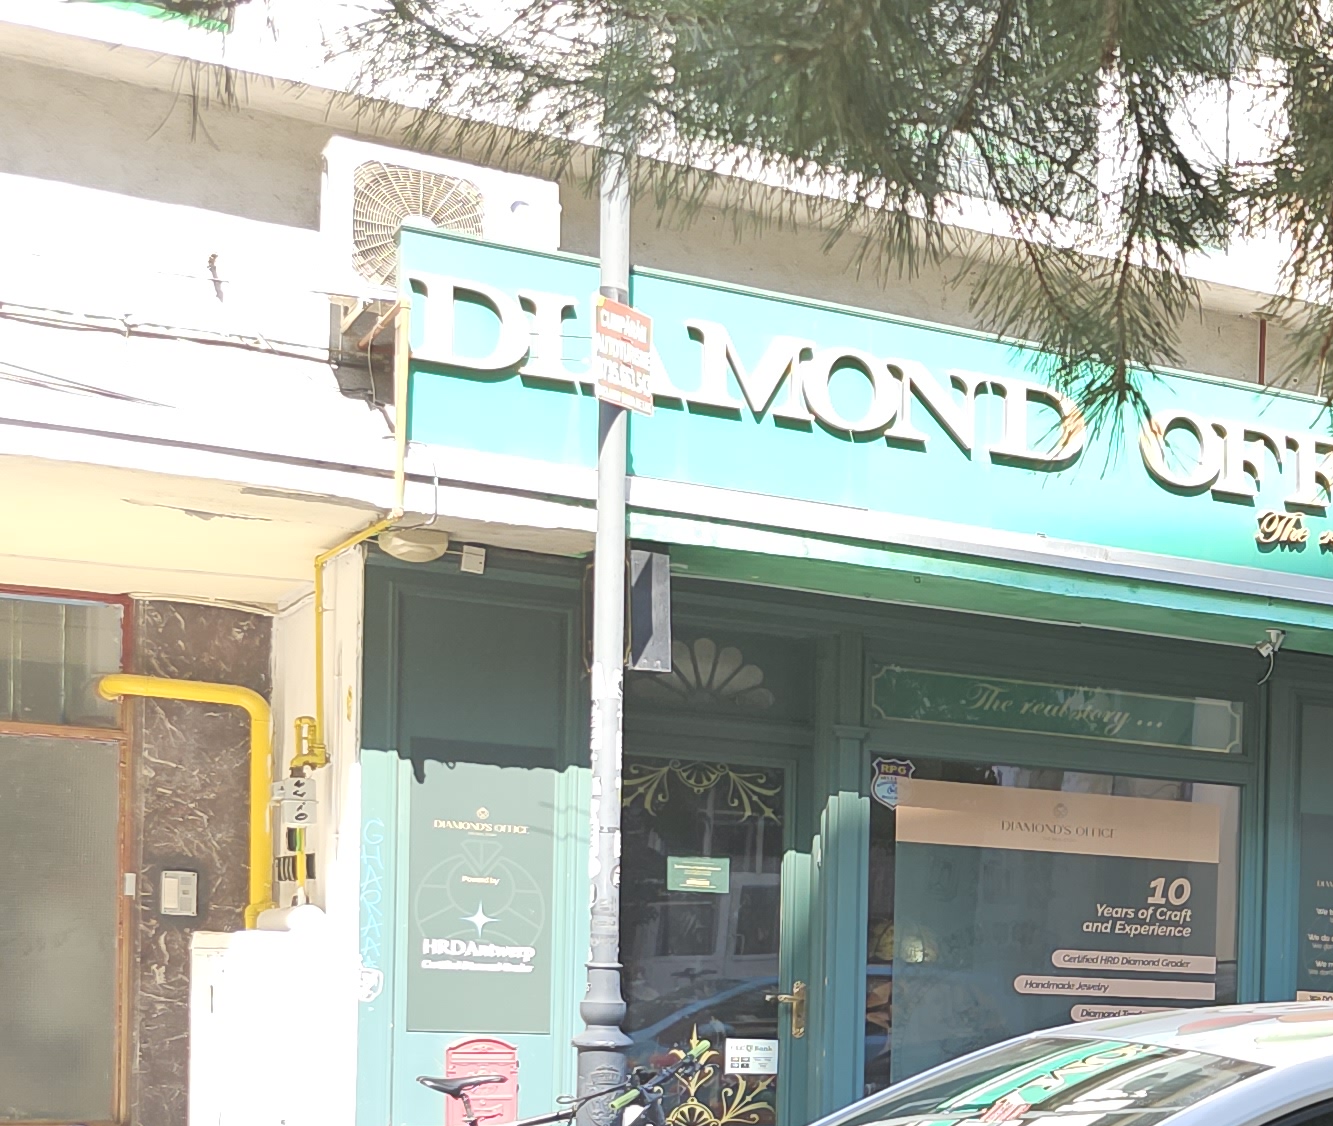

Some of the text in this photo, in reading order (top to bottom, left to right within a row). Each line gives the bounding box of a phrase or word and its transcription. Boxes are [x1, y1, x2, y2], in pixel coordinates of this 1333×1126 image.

[1255, 511, 1308, 545] The
[967, 682, 1012, 712] The
[880, 763, 907, 775] RPG
[1147, 877, 1192, 905] 10
[1096, 903, 1192, 924] Years of Craft
[1082, 920, 1192, 938] and Experience
[1062, 954, 1191, 969] Certified HRD Diamond Grader
[1024, 979, 1109, 993] Handmade Jewelry
[1080, 1009, 1121, 1019] Diamond
